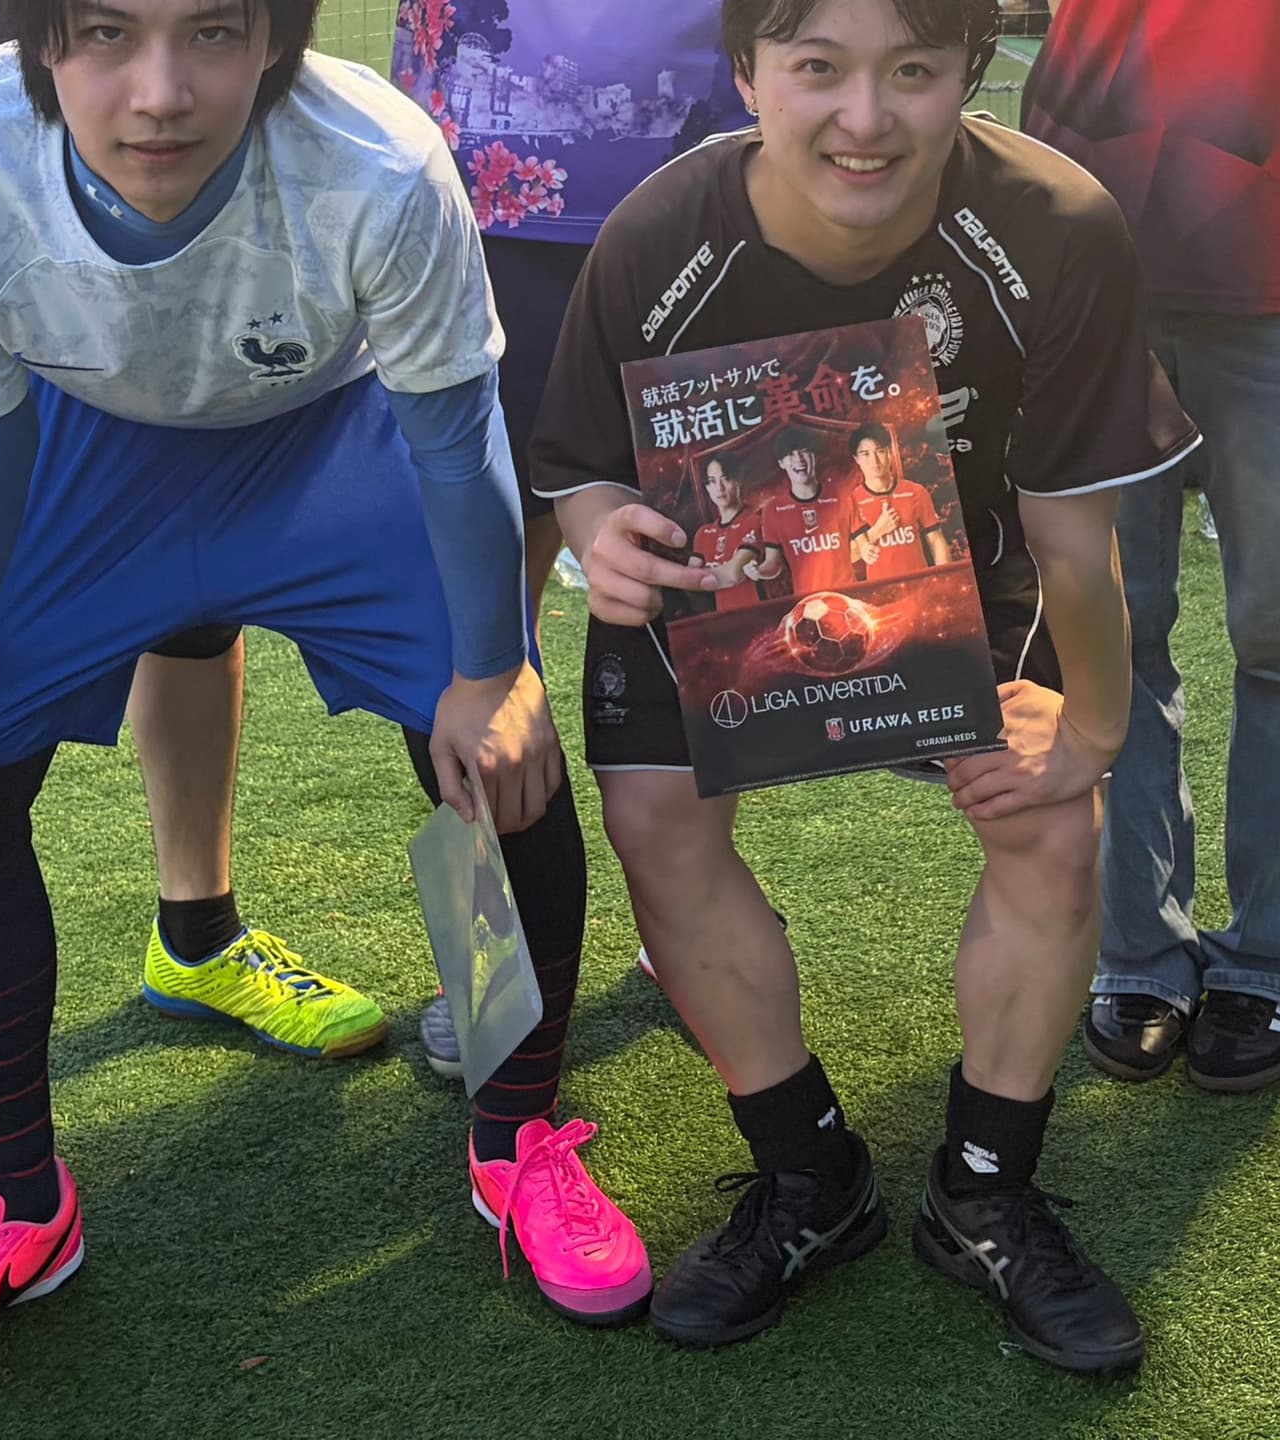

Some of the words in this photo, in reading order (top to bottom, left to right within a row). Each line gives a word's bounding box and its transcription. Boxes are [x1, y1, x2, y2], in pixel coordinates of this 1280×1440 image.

[641, 359, 781, 409] 就活フットサルで
[650, 365, 901, 449] 就活に革命を。
[789, 533, 841, 555] POLUS
[850, 714, 913, 734] URAWA
[918, 704, 965, 723] REDS
